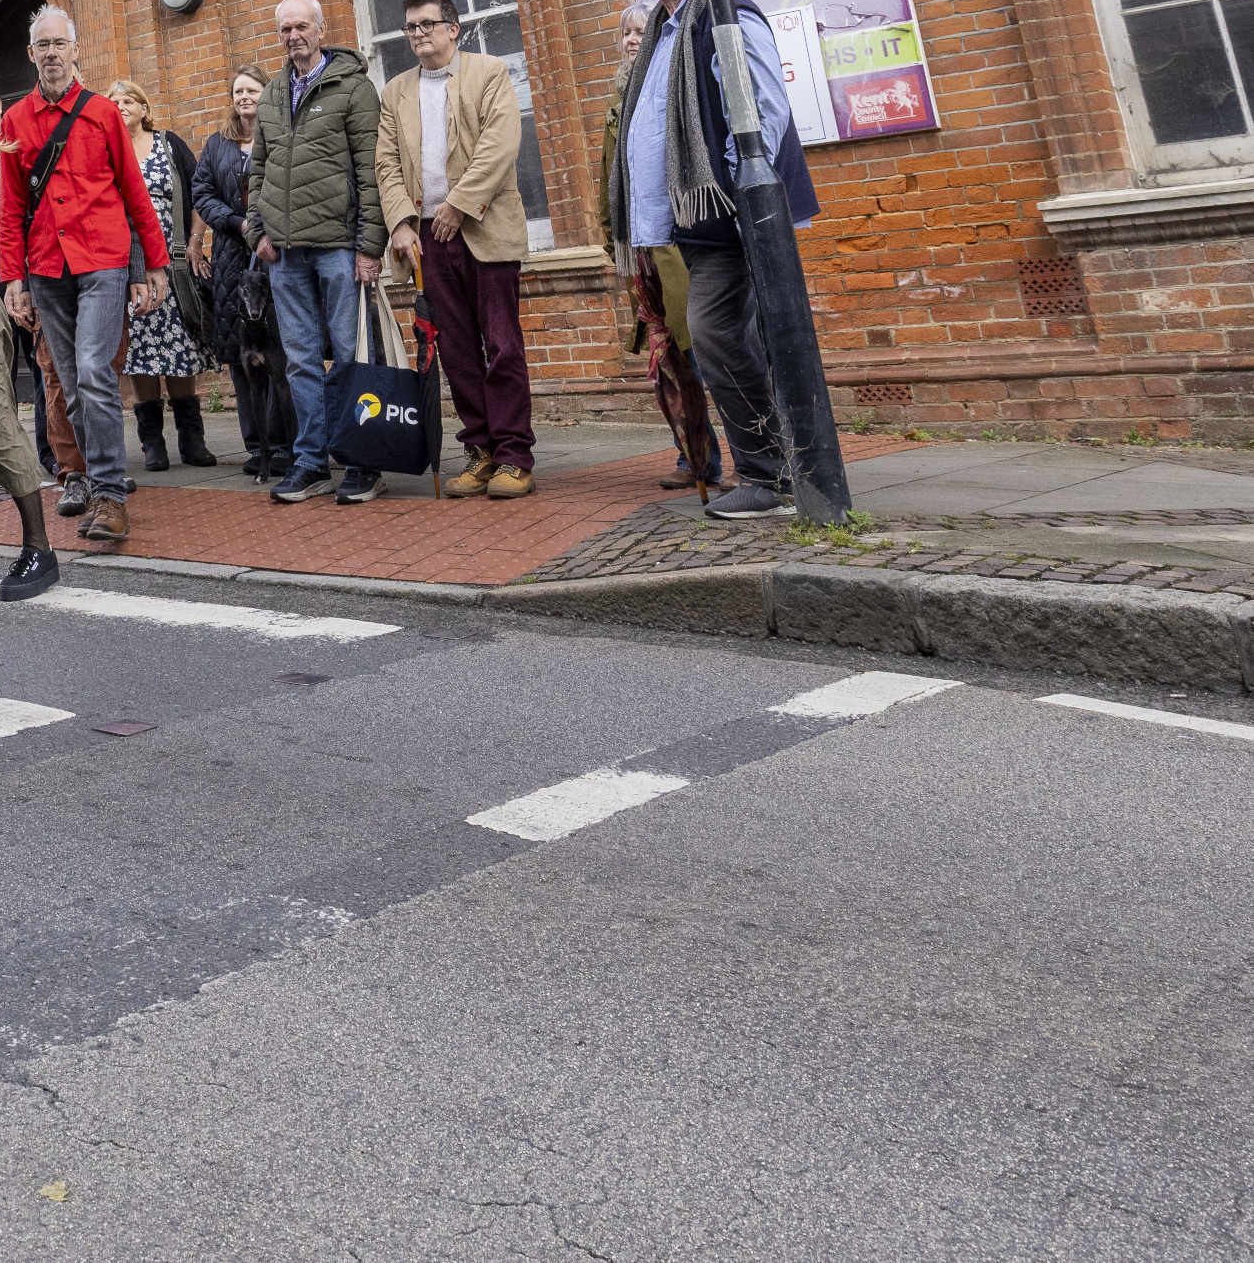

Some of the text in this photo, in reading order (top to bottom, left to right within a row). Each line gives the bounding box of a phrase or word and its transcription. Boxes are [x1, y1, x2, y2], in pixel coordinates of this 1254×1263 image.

[882, 37, 902, 58] IT
[849, 91, 890, 111] Kent
[385, 403, 419, 425] PIC
